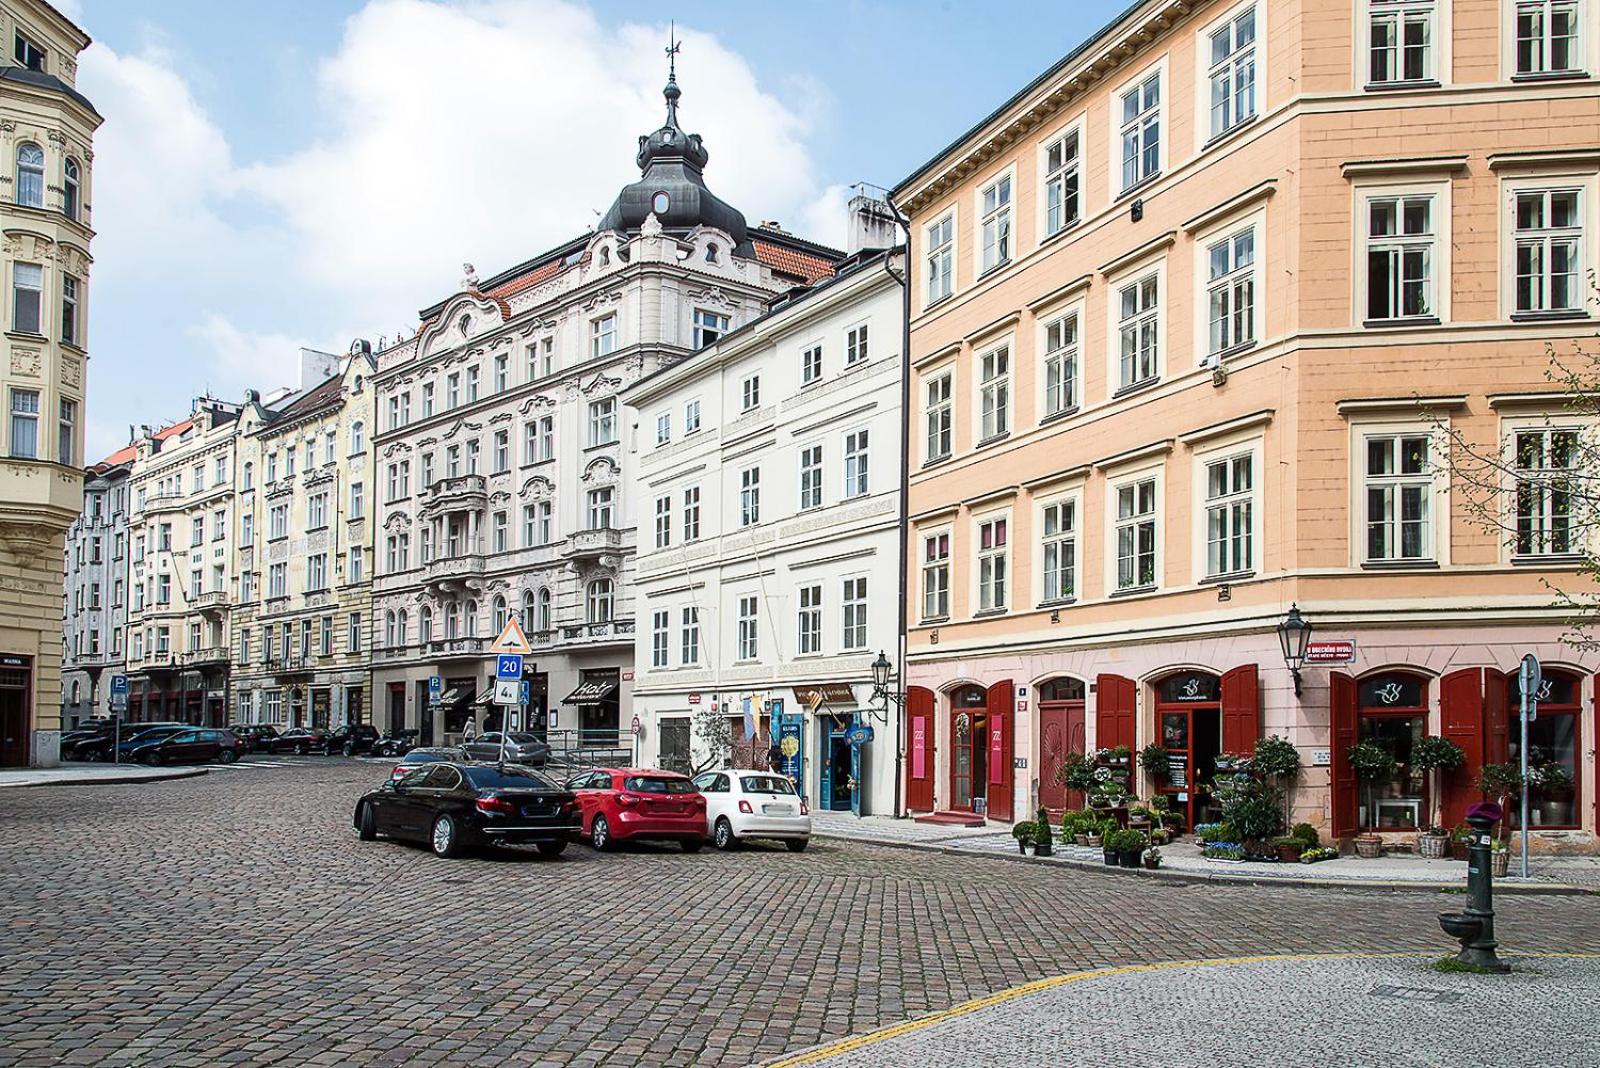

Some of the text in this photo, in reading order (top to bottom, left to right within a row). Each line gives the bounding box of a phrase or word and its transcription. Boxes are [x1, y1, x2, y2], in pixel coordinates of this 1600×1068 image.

[502, 661, 517, 672] 20
[116, 678, 125, 687] P
[432, 678, 439, 686] P
